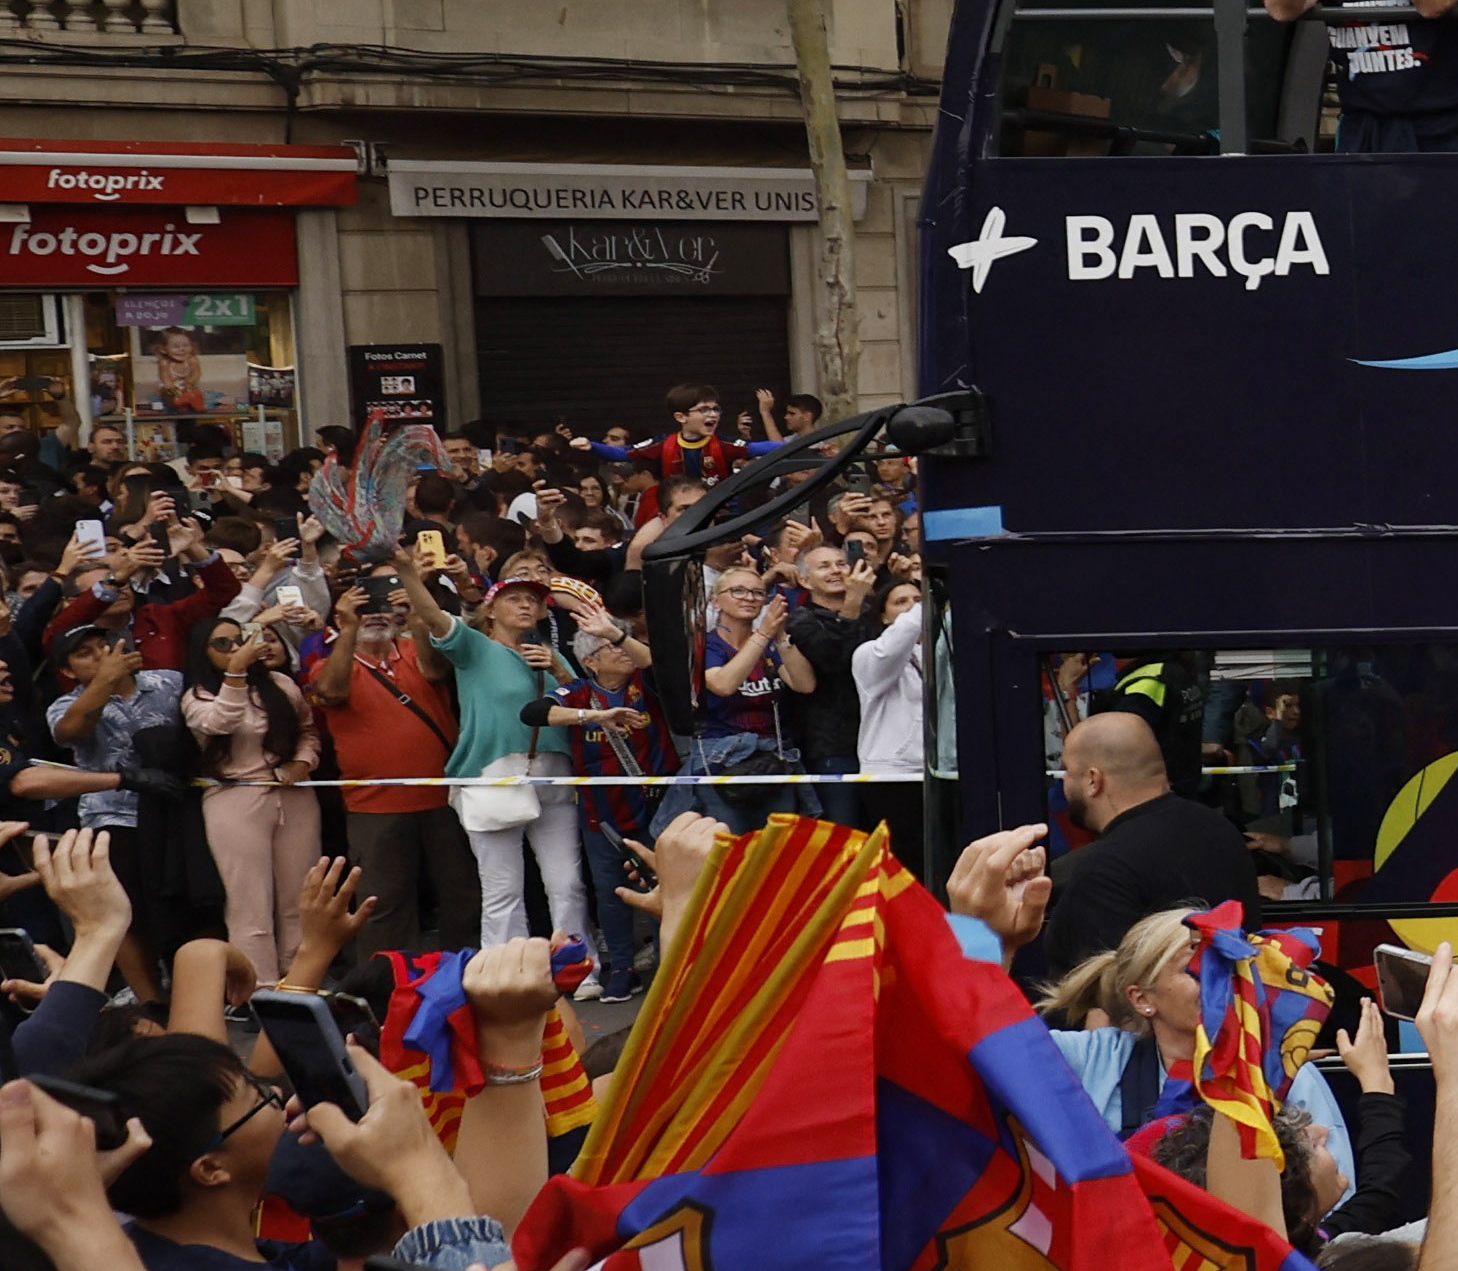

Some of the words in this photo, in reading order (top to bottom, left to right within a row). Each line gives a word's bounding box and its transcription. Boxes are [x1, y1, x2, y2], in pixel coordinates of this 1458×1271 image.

[1346, 47, 1422, 73] JUNTES.
[47, 168, 165, 194] fotoprix
[414, 186, 615, 212] PERRUQUERIA
[621, 189, 747, 211] KAR&VER
[9, 223, 203, 264] fotoprix
[1065, 210, 1330, 291] BARÇA
[194, 294, 250, 317] 2x1
[364, 352, 393, 361] Fotos
[394, 351, 427, 360] Carnet
